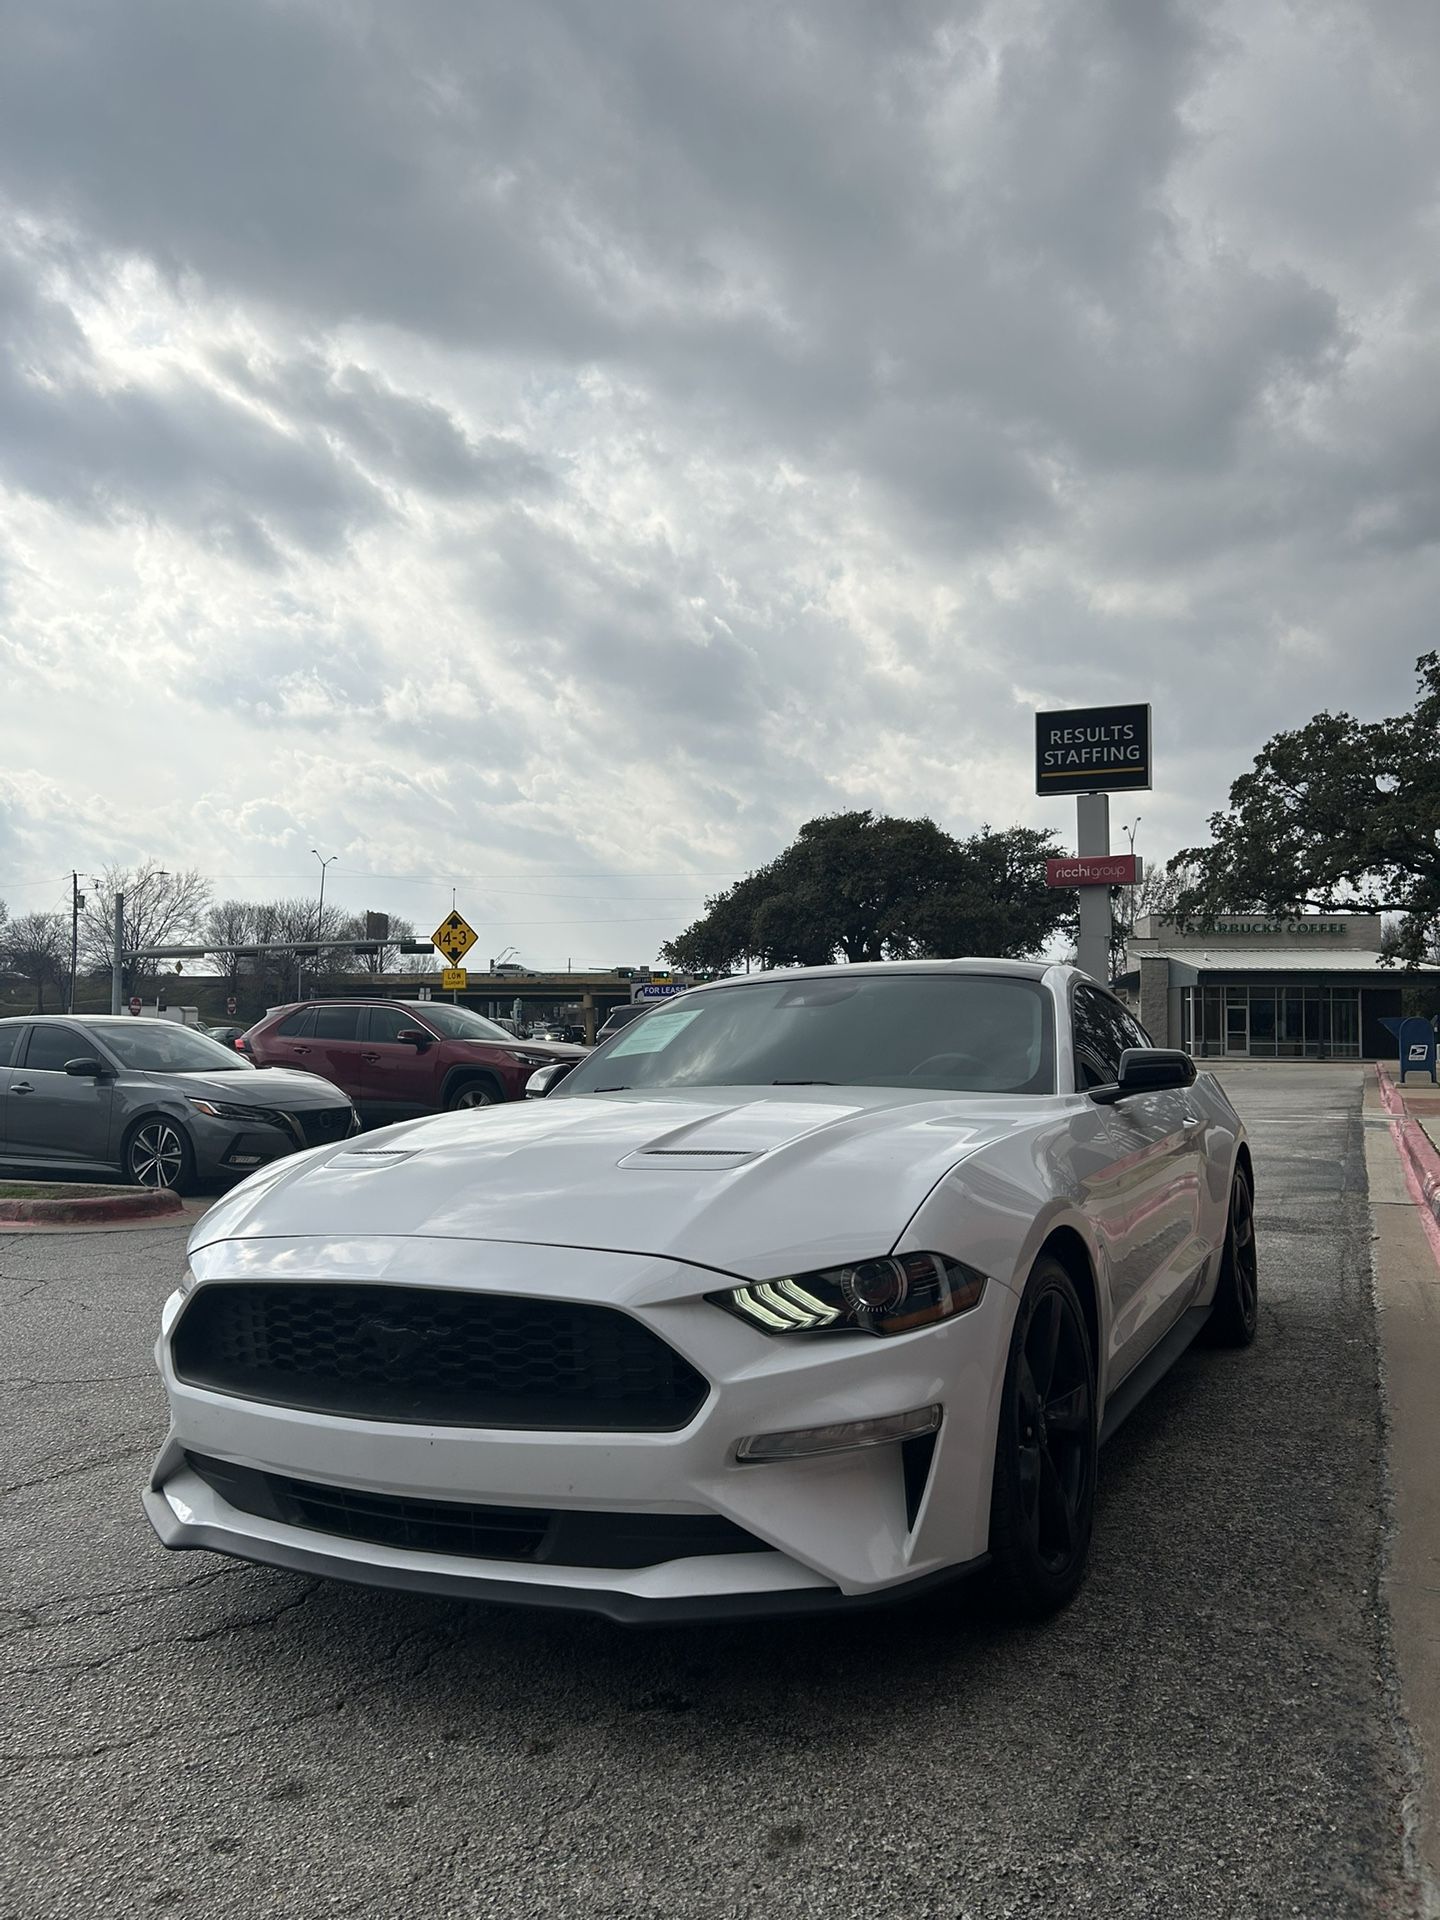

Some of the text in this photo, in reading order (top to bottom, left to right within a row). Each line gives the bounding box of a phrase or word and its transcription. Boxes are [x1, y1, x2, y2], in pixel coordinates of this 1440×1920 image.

[1050, 724, 1134, 745] RESULTS
[1044, 745, 1140, 765] STAFFING
[1287, 922, 1348, 934] COFFEE
[644, 986, 660, 994] FOR
